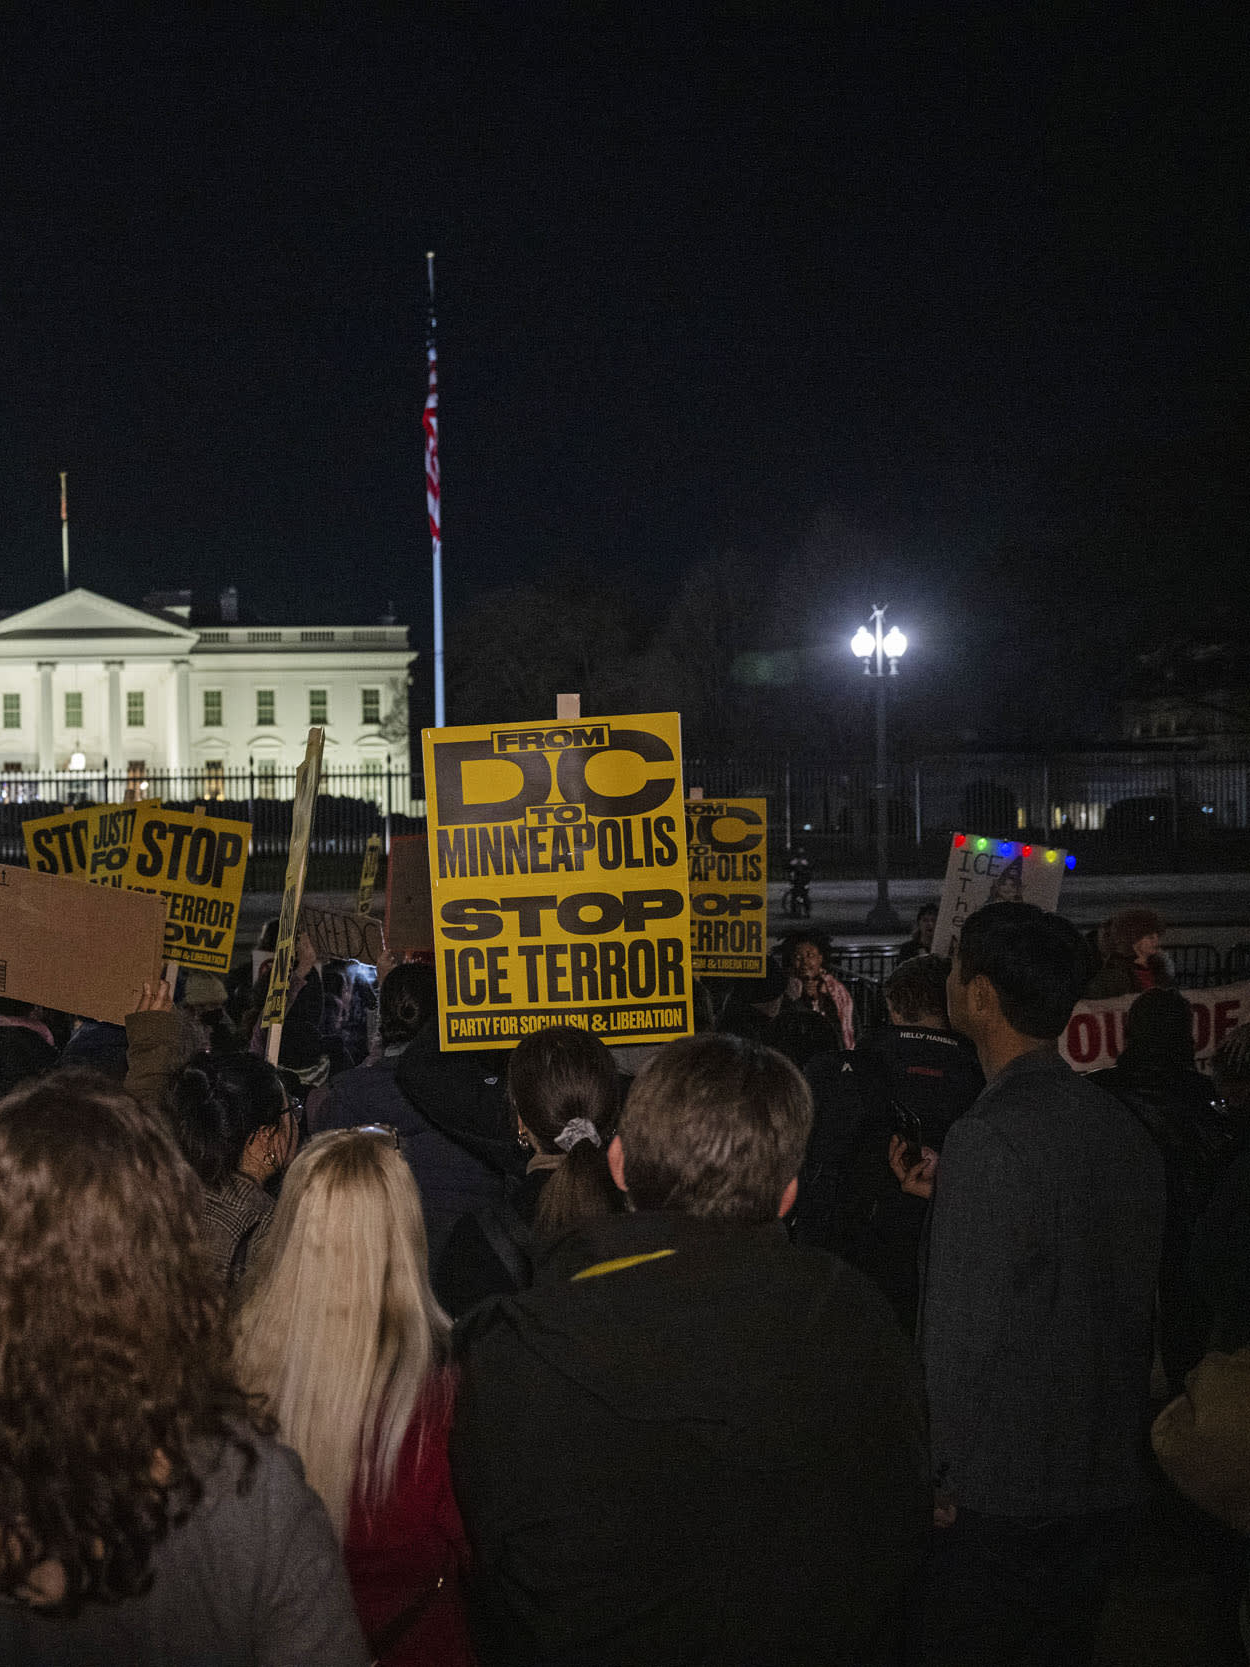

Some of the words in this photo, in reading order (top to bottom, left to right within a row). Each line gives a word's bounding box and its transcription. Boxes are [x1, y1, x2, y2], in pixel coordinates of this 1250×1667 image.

[495, 727, 607, 752] FROM
[434, 729, 676, 826] DC
[529, 805, 583, 827] TO
[33, 820, 88, 876] STO
[91, 846, 130, 874] FO
[136, 820, 243, 888] STOP
[436, 816, 680, 879] MINNEAPOLIS
[164, 922, 227, 949] OW
[440, 889, 686, 941] STOP
[444, 946, 512, 1006] ICE
[518, 937, 686, 1003] TERROR
[450, 1017, 491, 1037] PARTY
[493, 1016, 519, 1036] FOR
[591, 1013, 608, 1032] &
[610, 1007, 683, 1031] LIBERATION
[899, 1031, 925, 1040] HELLY
